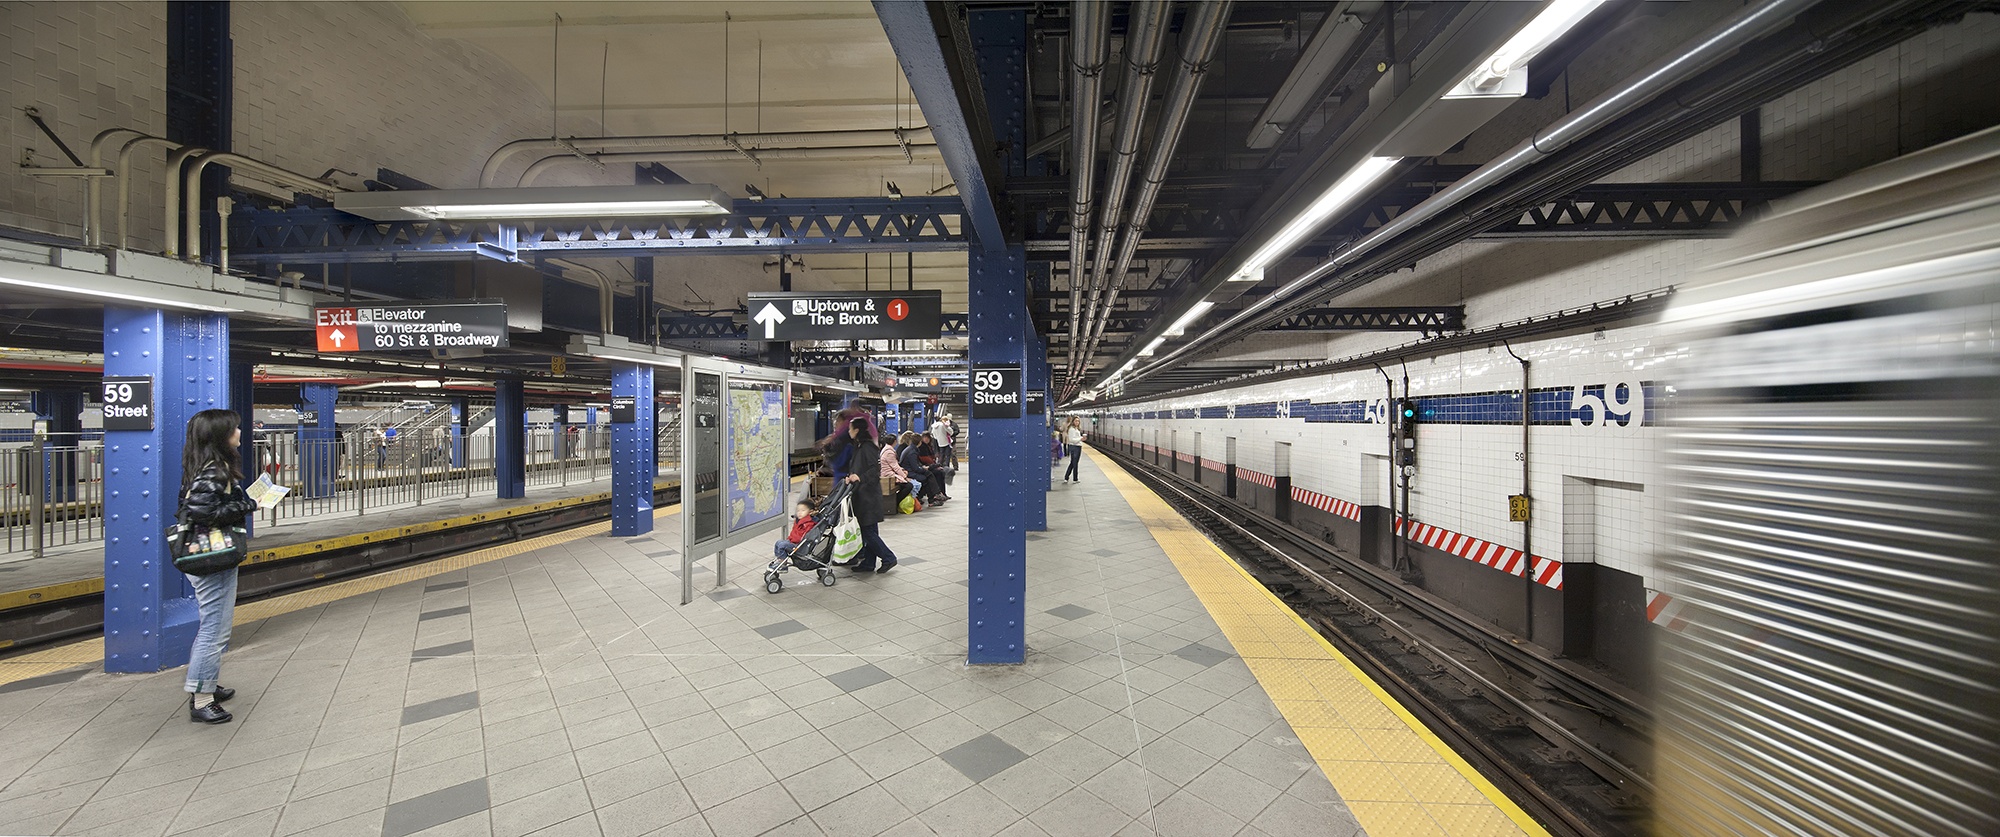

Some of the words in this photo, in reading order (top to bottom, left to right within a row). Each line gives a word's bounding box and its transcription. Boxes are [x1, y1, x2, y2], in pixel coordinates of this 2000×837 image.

[808, 299, 860, 314] Uptown
[865, 299, 875, 311] &
[894, 303, 902, 316] 1
[317, 309, 353, 326] Exit
[372, 308, 426, 320] Elevator
[808, 313, 834, 325] The
[839, 313, 879, 325] Bronx
[374, 323, 388, 334] to
[392, 320, 462, 333] mezzanine
[375, 335, 394, 348] 60
[399, 334, 414, 347] St
[419, 334, 429, 346] &
[434, 333, 500, 348] Broadway
[973, 370, 1003, 390] 59
[104, 383, 133, 403] 59
[974, 391, 1018, 405] Street
[104, 405, 148, 418] Street
[1276, 400, 1291, 420] 59
[1570, 372, 1645, 437] 59
[1515, 452, 1524, 462] 59
[1511, 509, 1527, 518] 20
